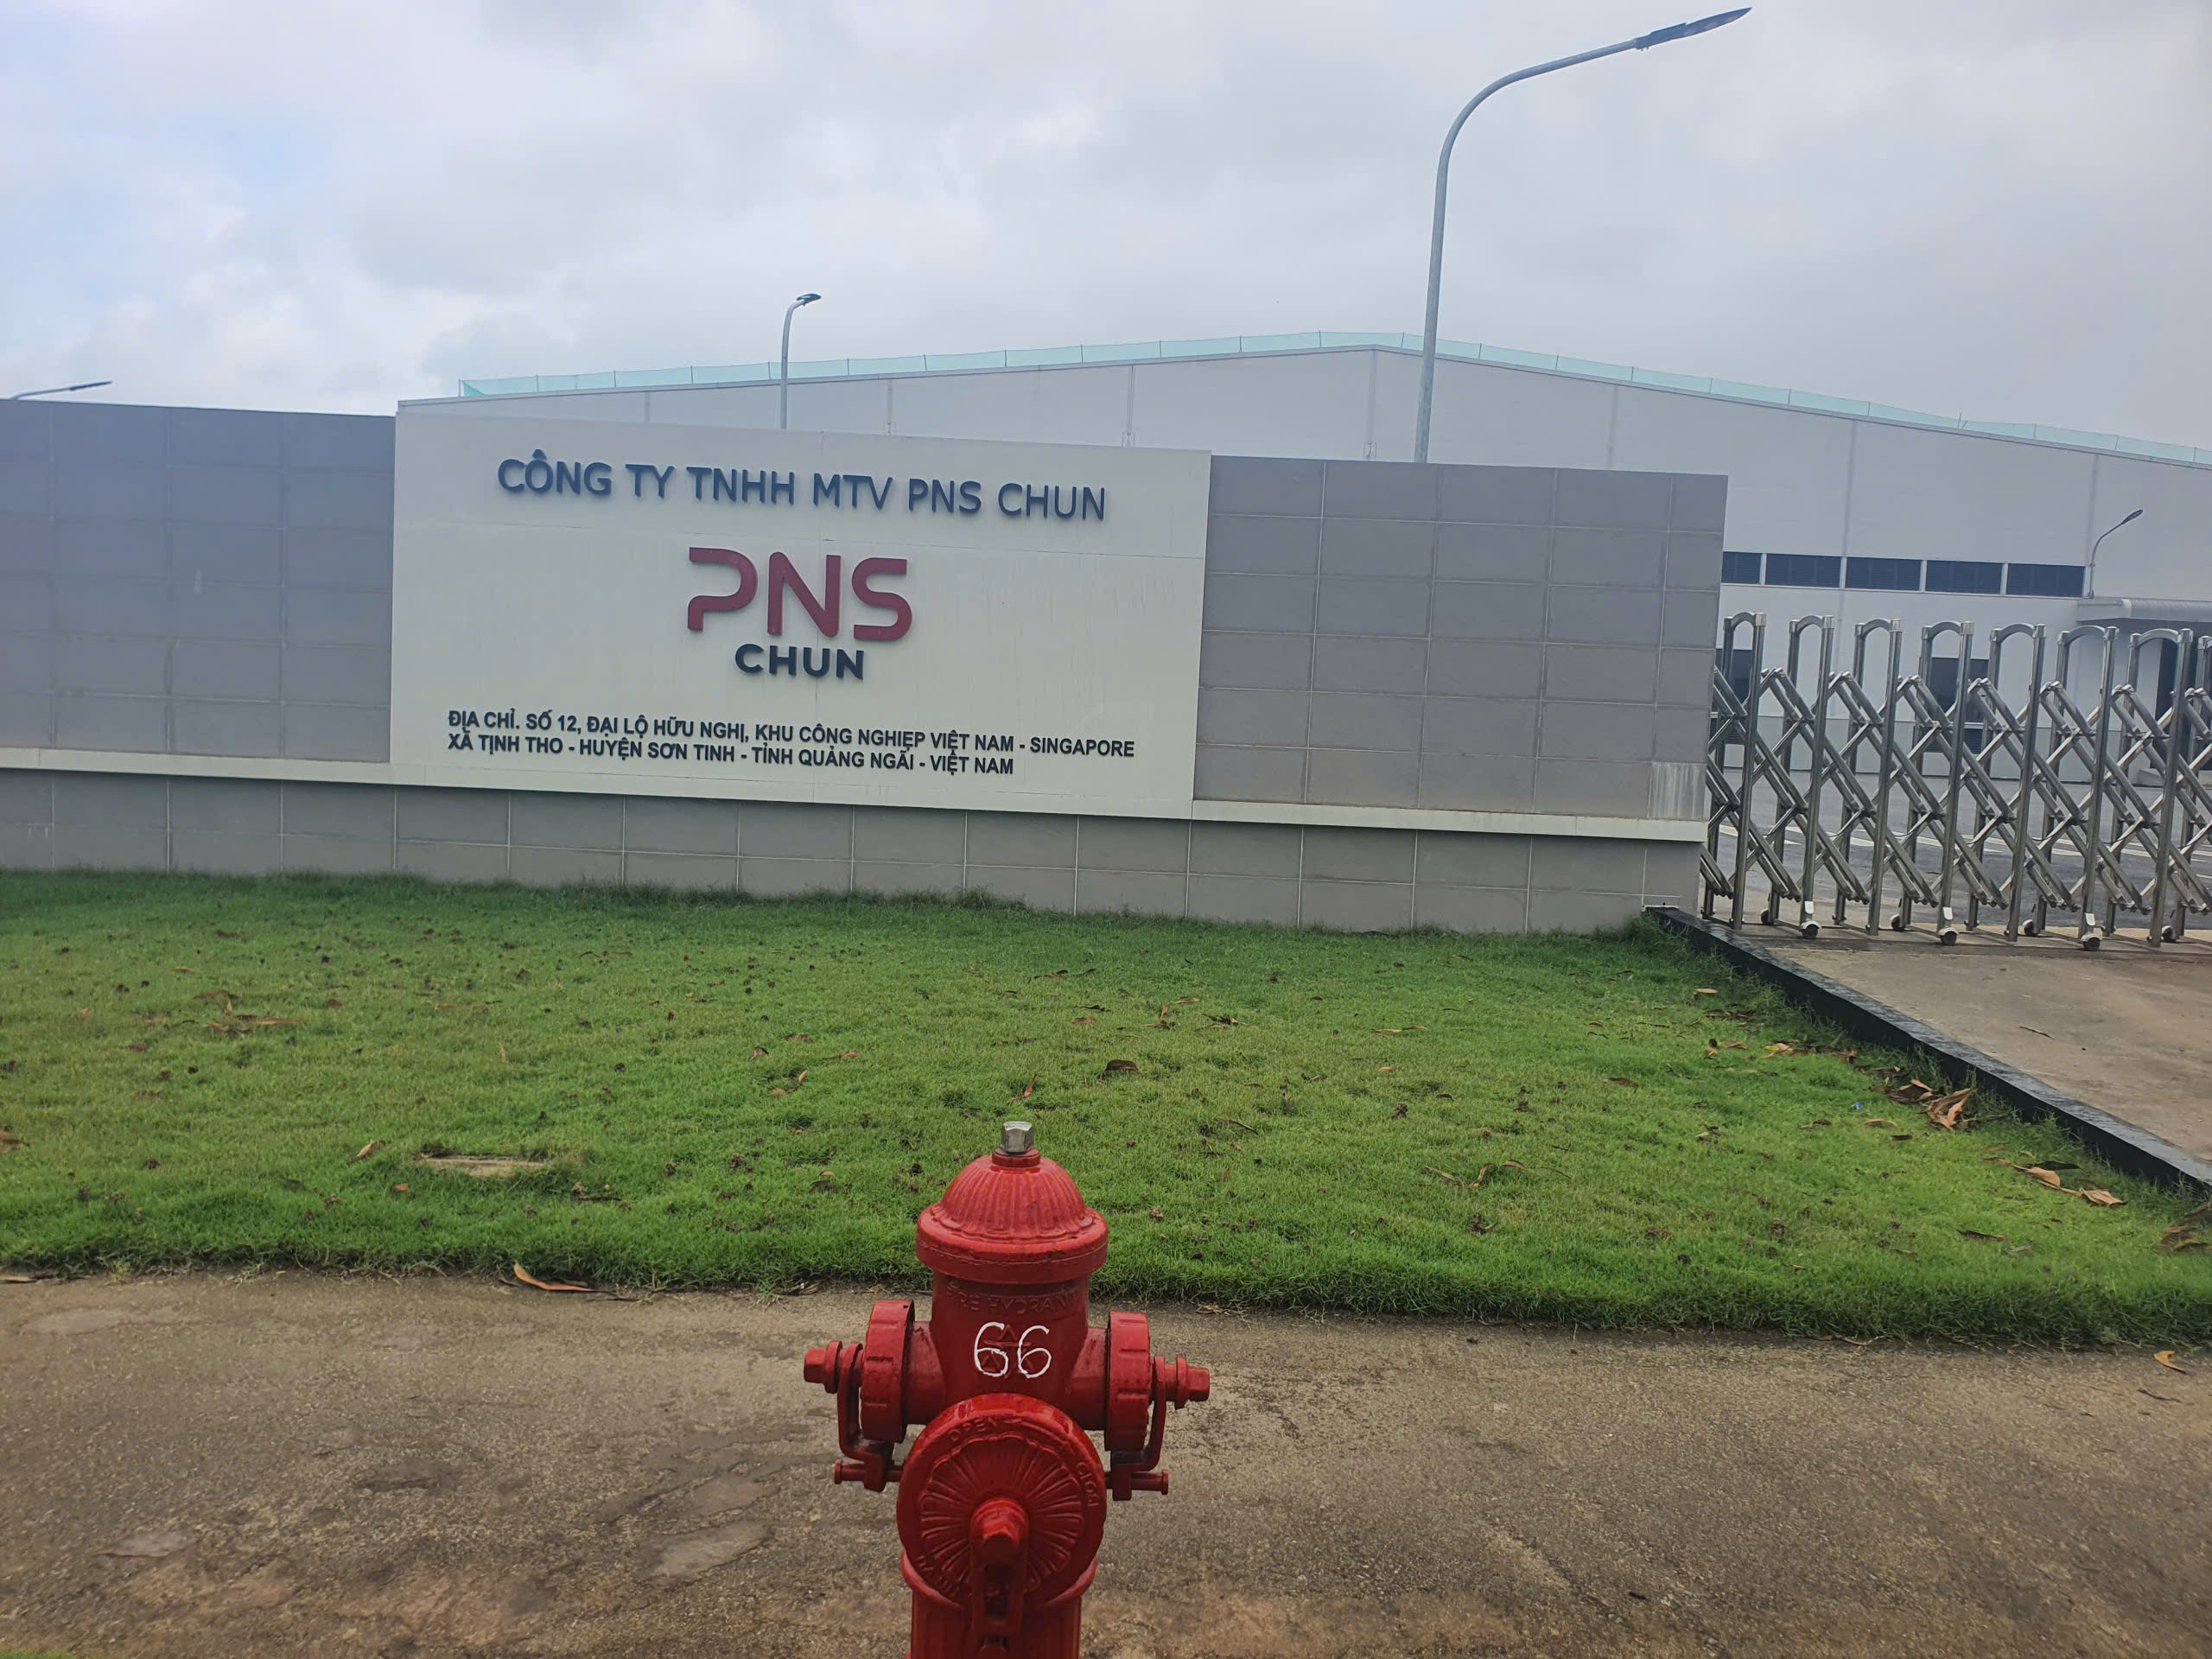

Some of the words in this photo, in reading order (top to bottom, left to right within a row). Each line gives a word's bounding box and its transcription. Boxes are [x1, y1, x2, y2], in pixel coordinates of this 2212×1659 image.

[498, 448, 613, 497] CÔNG
[625, 464, 676, 499] TY
[686, 467, 795, 505] TNHH
[813, 473, 893, 510] MTV
[908, 478, 982, 514] PNS
[998, 482, 1105, 520] CHUN
[687, 546, 912, 641] PNS
[734, 643, 864, 680] CHUN
[448, 709, 480, 730] ĐỊA
[525, 709, 552, 730] SỐ
[557, 715, 582, 734] 12,
[587, 715, 618, 737] ĐẠI
[624, 715, 649, 739] LỘ
[654, 716, 694, 737] HỮU
[700, 721, 749, 743] NGHỊ,
[755, 724, 793, 742] KHU
[799, 723, 852, 744] CÔNG
[931, 729, 969, 752] VIỆT
[975, 734, 1014, 752] NAM
[1030, 737, 1135, 757] SINGAPORE
[448, 729, 474, 750] XÃ
[478, 734, 519, 754] TỊNH
[580, 737, 642, 760] HUYỆN
[648, 742, 687, 760] SƠN
[752, 742, 793, 765] TỈNH
[798, 745, 864, 767] QUẢNG
[870, 750, 913, 770] NGÃI
[930, 749, 969, 776] VIỆT
[975, 758, 1014, 774] NAM
[973, 1321, 1052, 1379] 66
